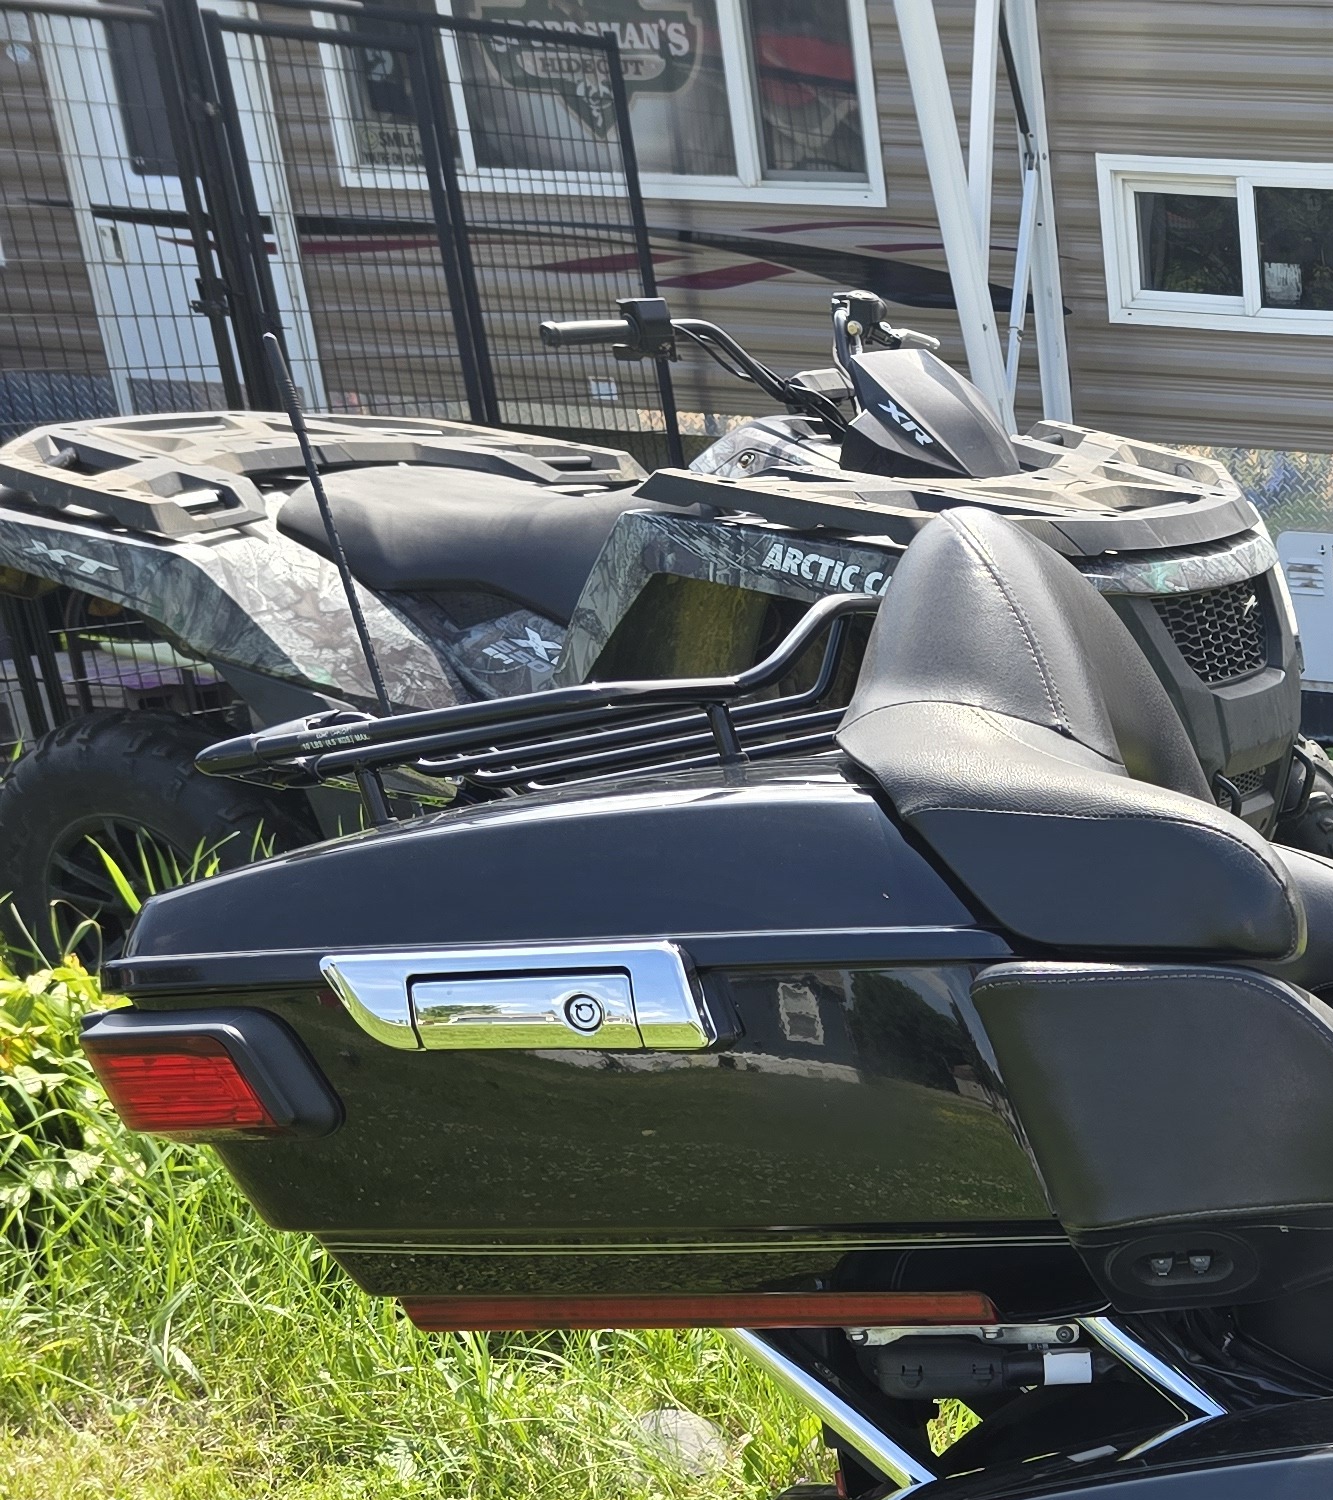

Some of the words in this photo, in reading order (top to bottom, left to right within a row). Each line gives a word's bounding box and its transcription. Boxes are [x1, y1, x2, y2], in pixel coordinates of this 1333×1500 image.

[878, 400, 934, 446] XR
[23, 539, 120, 575] XT
[761, 543, 861, 592] ARCTIC
